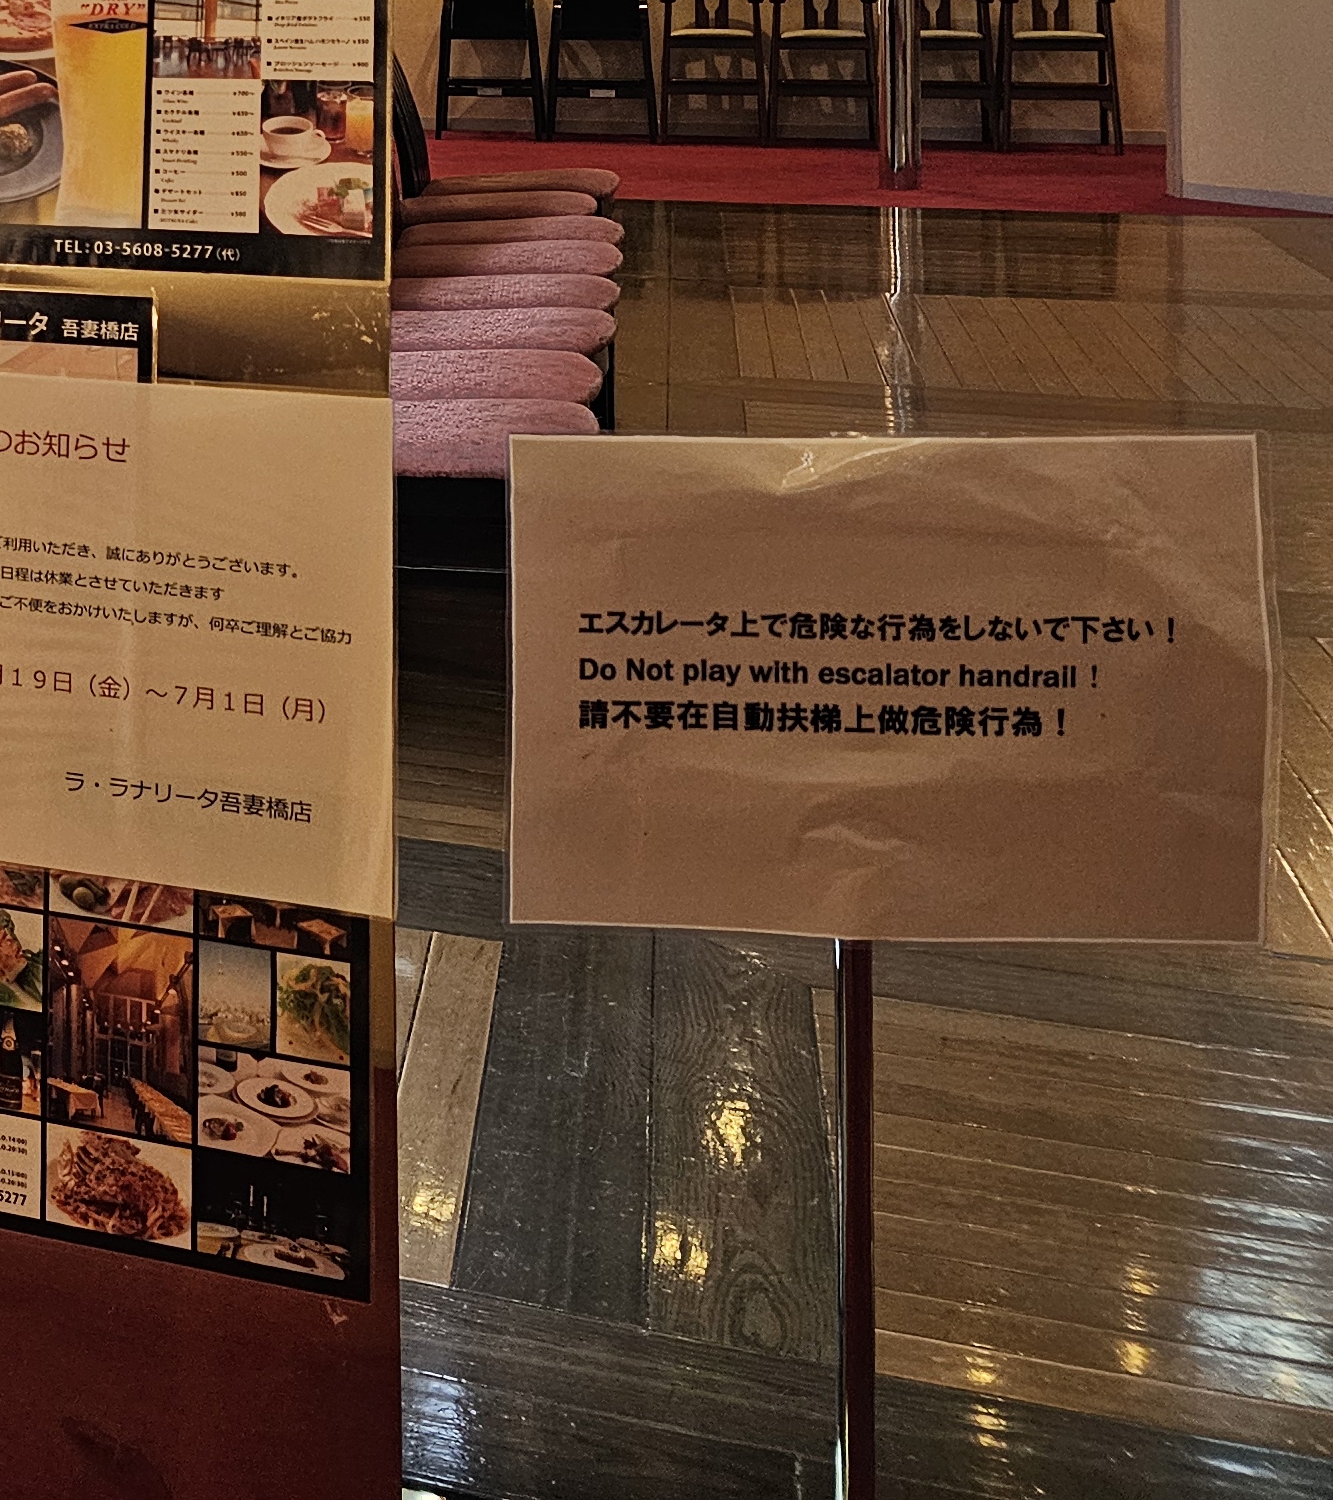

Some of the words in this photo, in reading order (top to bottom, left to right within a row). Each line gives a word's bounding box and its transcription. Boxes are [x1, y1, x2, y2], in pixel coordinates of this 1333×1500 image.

[61, 319, 139, 341] 吾妻橋店
[579, 658, 617, 681] Do
[626, 658, 674, 681] Not
[683, 659, 741, 686] play
[749, 660, 809, 684] with
[818, 663, 950, 687] escalator
[65, 771, 312, 824] ラ・ラナリータ吾妻橋店
